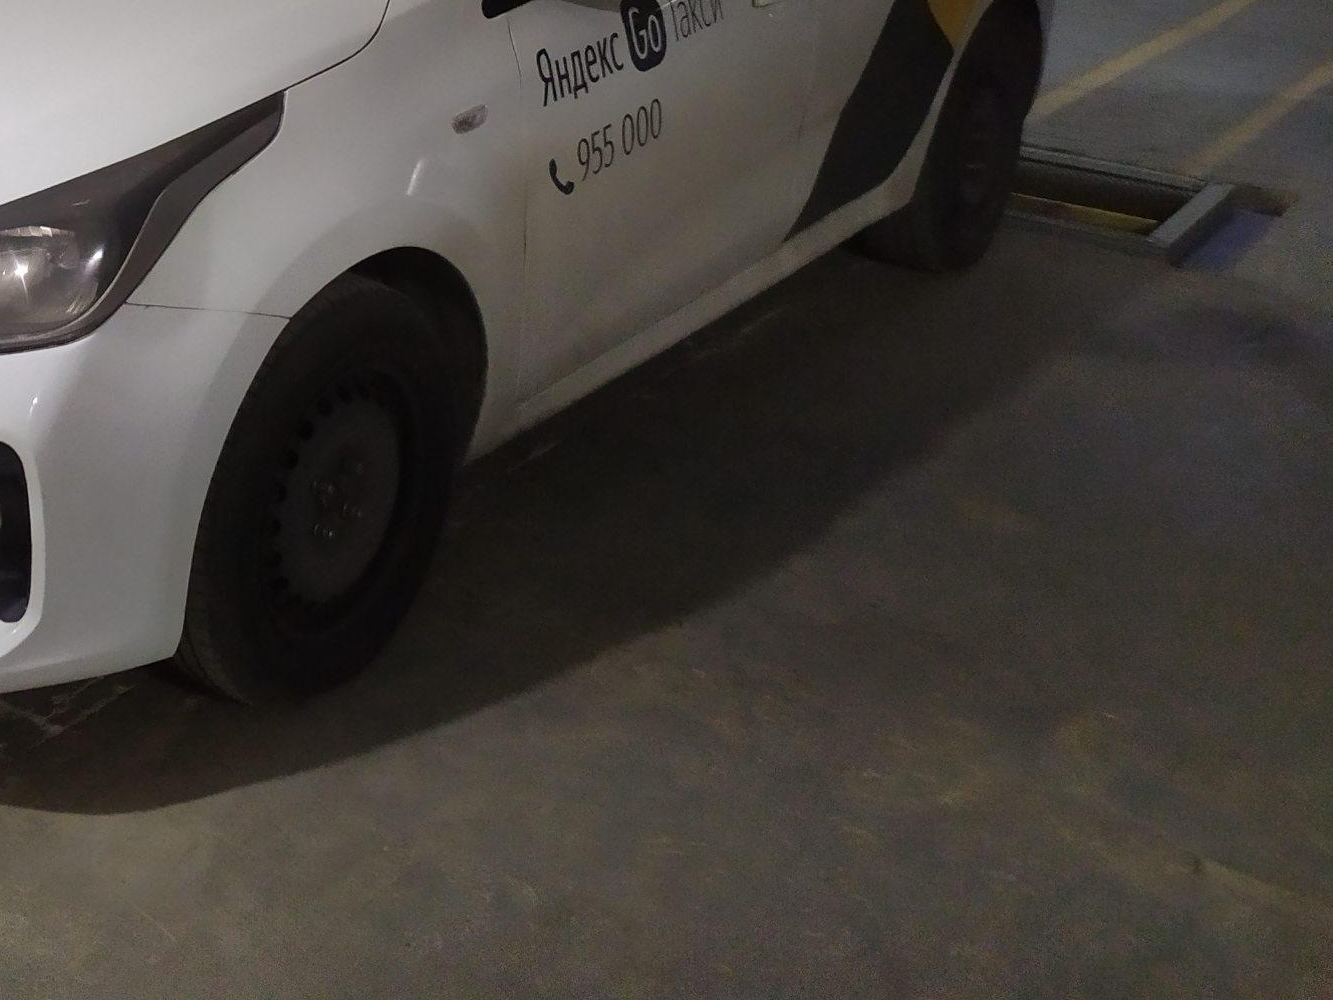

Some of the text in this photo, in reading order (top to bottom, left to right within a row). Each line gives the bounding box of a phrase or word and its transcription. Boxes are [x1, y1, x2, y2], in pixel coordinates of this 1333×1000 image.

[536, 32, 624, 107] Яндекс
[627, 6, 663, 59] Go
[577, 98, 662, 182] 955 000
